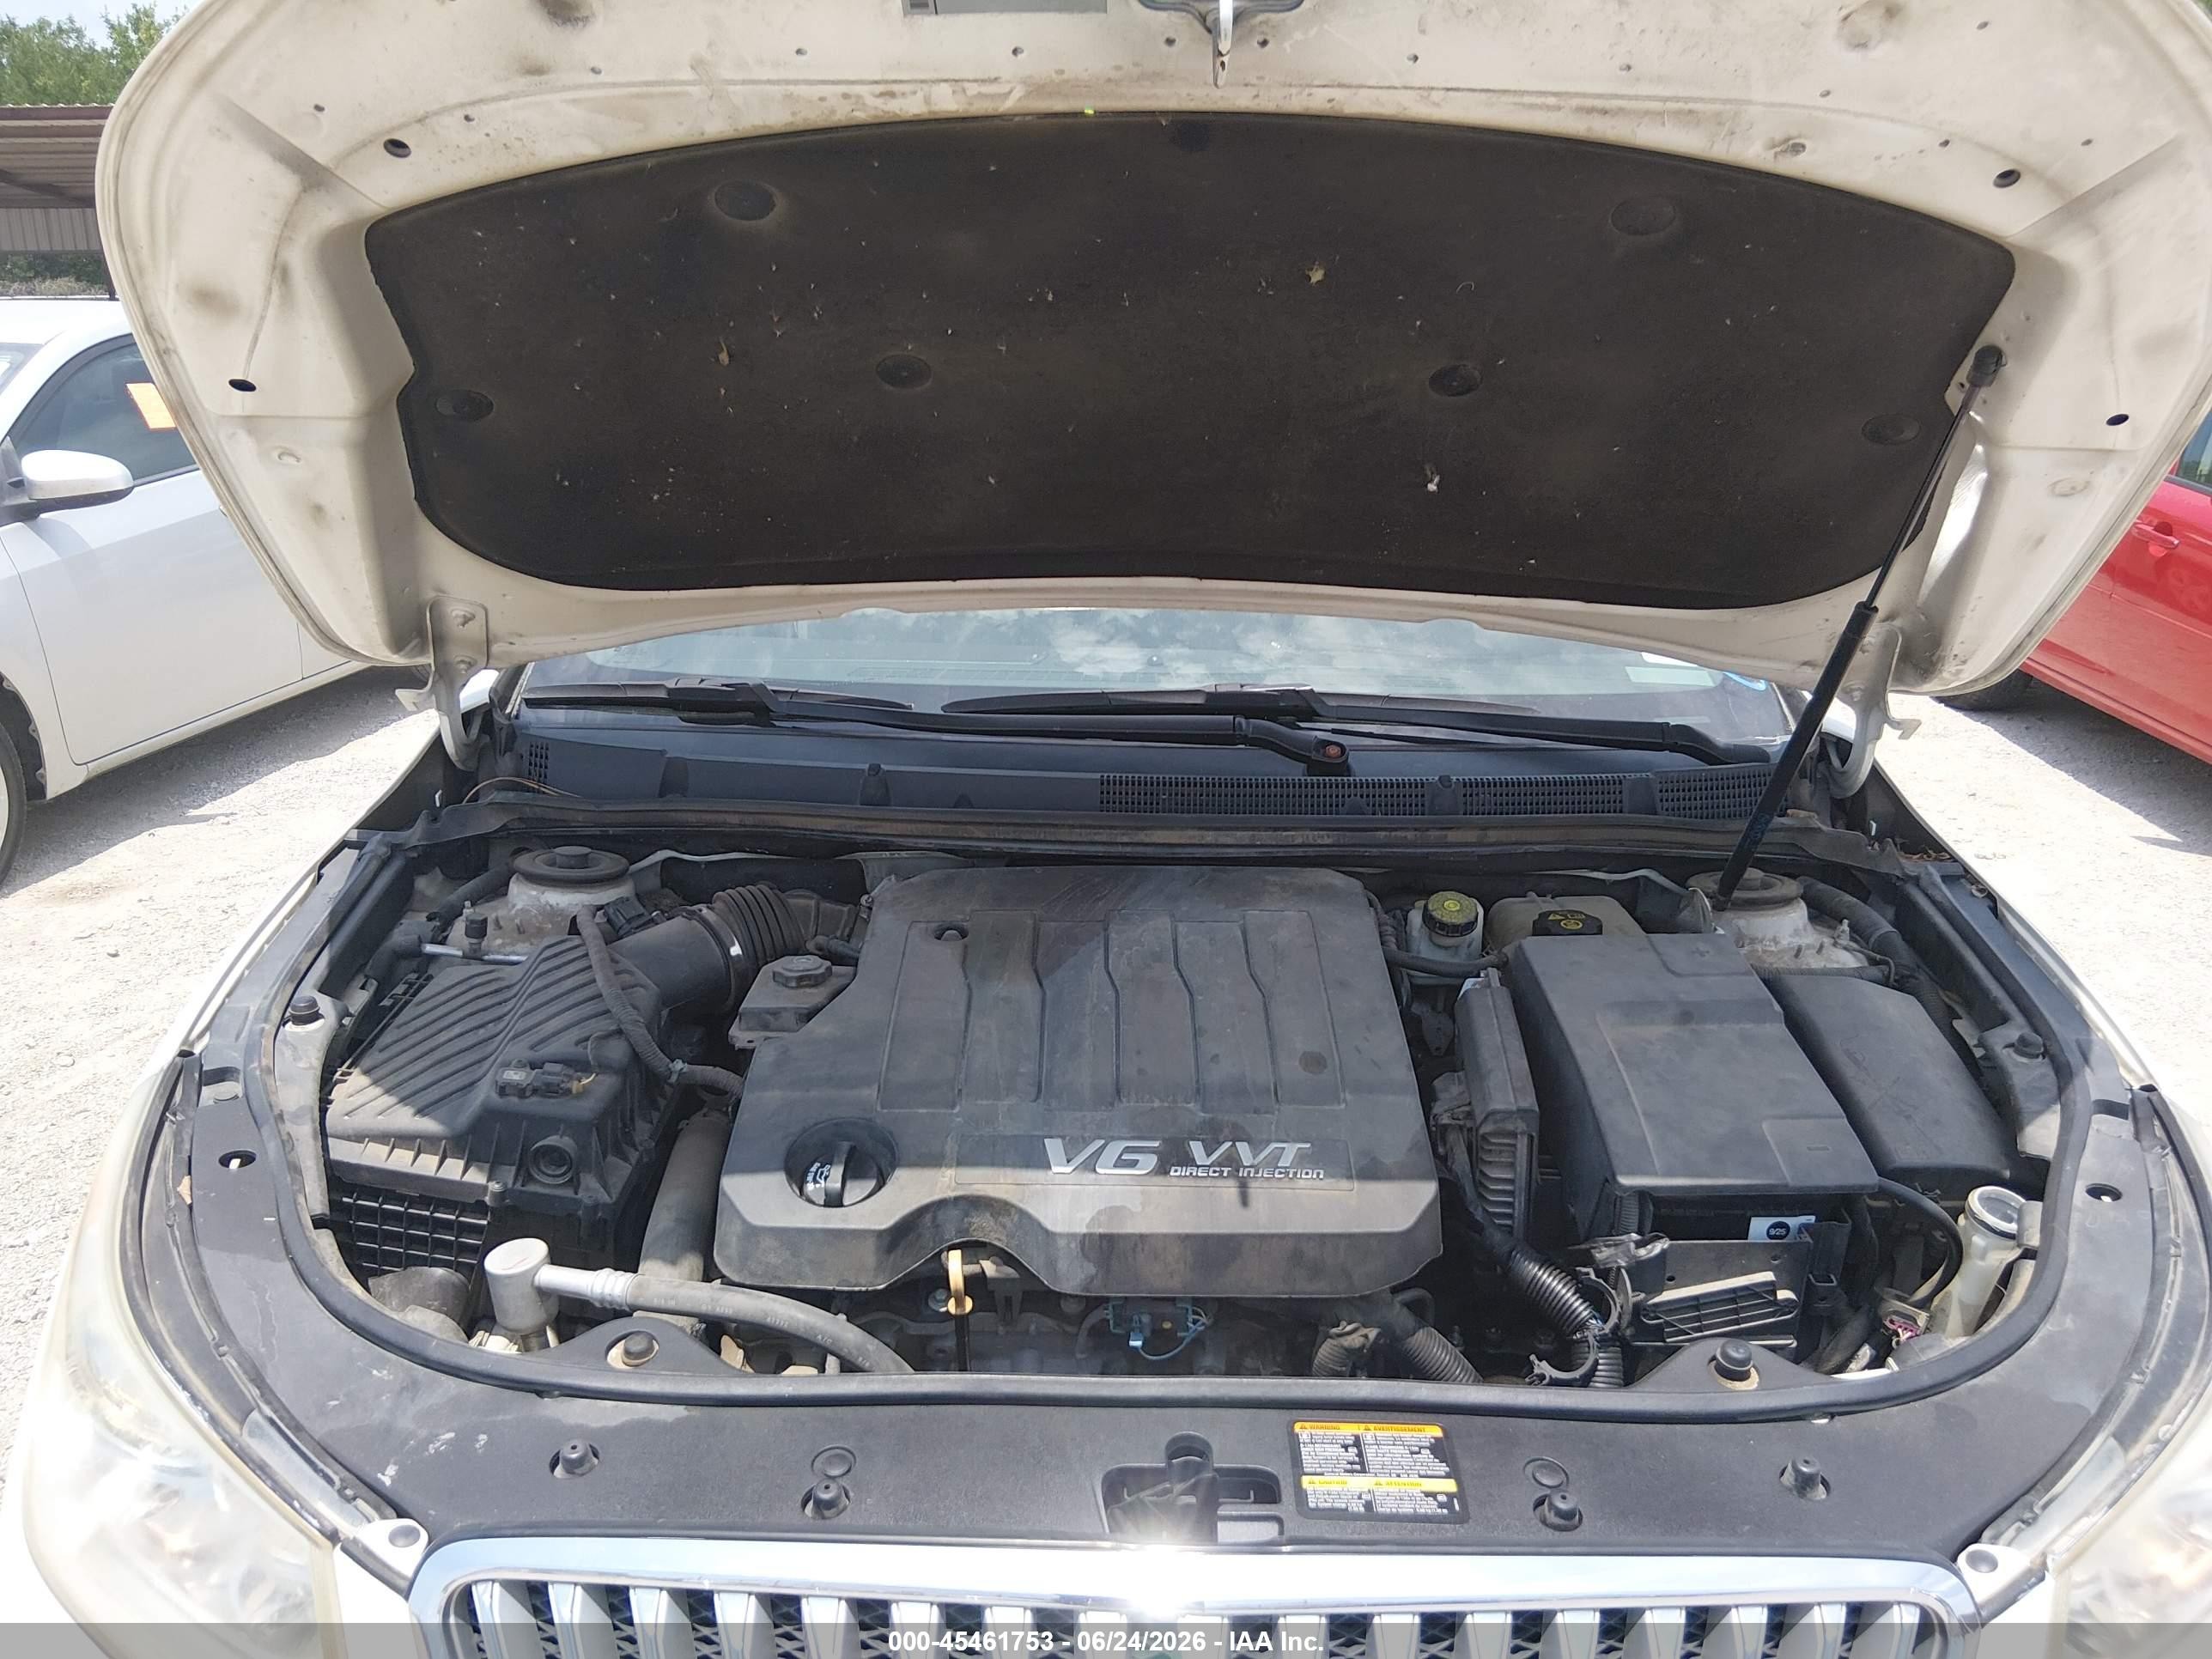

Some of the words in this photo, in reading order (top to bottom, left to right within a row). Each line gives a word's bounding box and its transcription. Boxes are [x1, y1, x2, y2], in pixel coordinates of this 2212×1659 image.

[1043, 1138, 1161, 1175] V6
[1188, 1140, 1312, 1167] VVT
[1170, 1166, 1231, 1177] DIRECT
[1238, 1167, 1325, 1179] INJECTION
